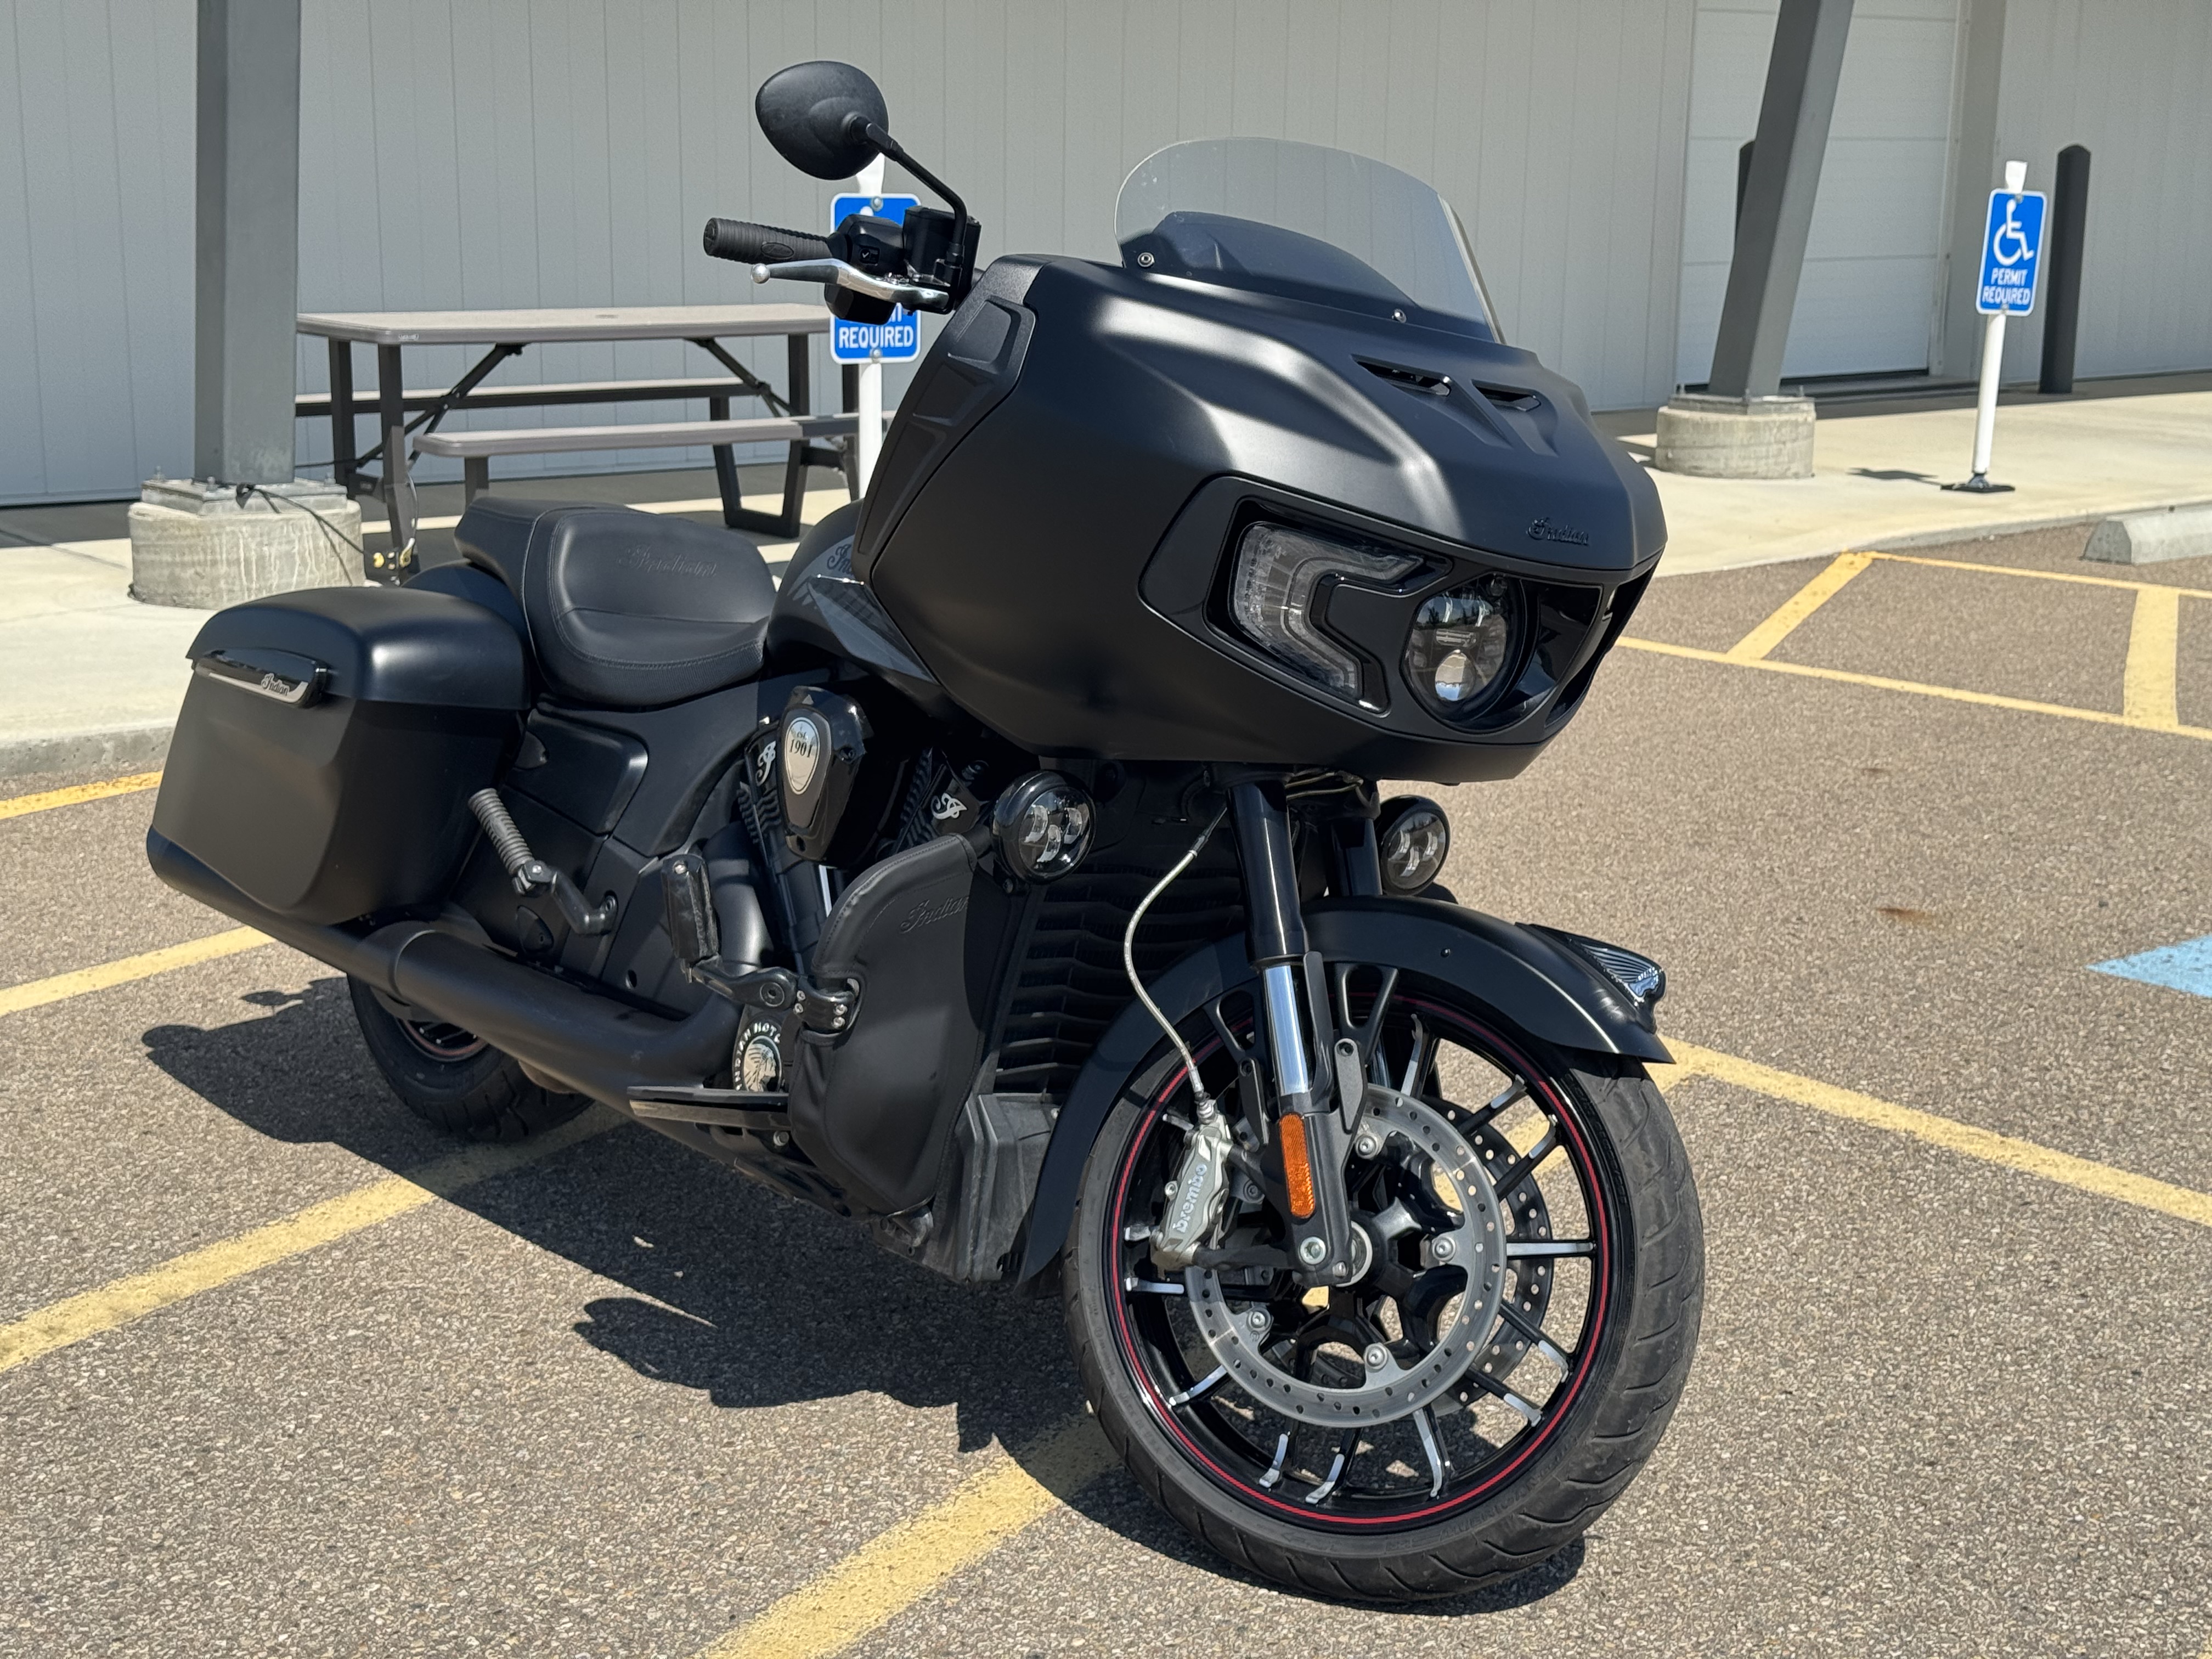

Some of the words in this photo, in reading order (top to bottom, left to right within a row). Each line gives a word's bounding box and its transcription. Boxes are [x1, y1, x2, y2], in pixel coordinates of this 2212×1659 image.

[1991, 268, 2028, 285] PERMIT
[1982, 286, 2030, 305] REQUIRED
[839, 326, 913, 348] REQUIRED
[262, 674, 289, 697] Indian
[789, 739, 814, 758] 1901
[1172, 1164, 1207, 1233] brembo
